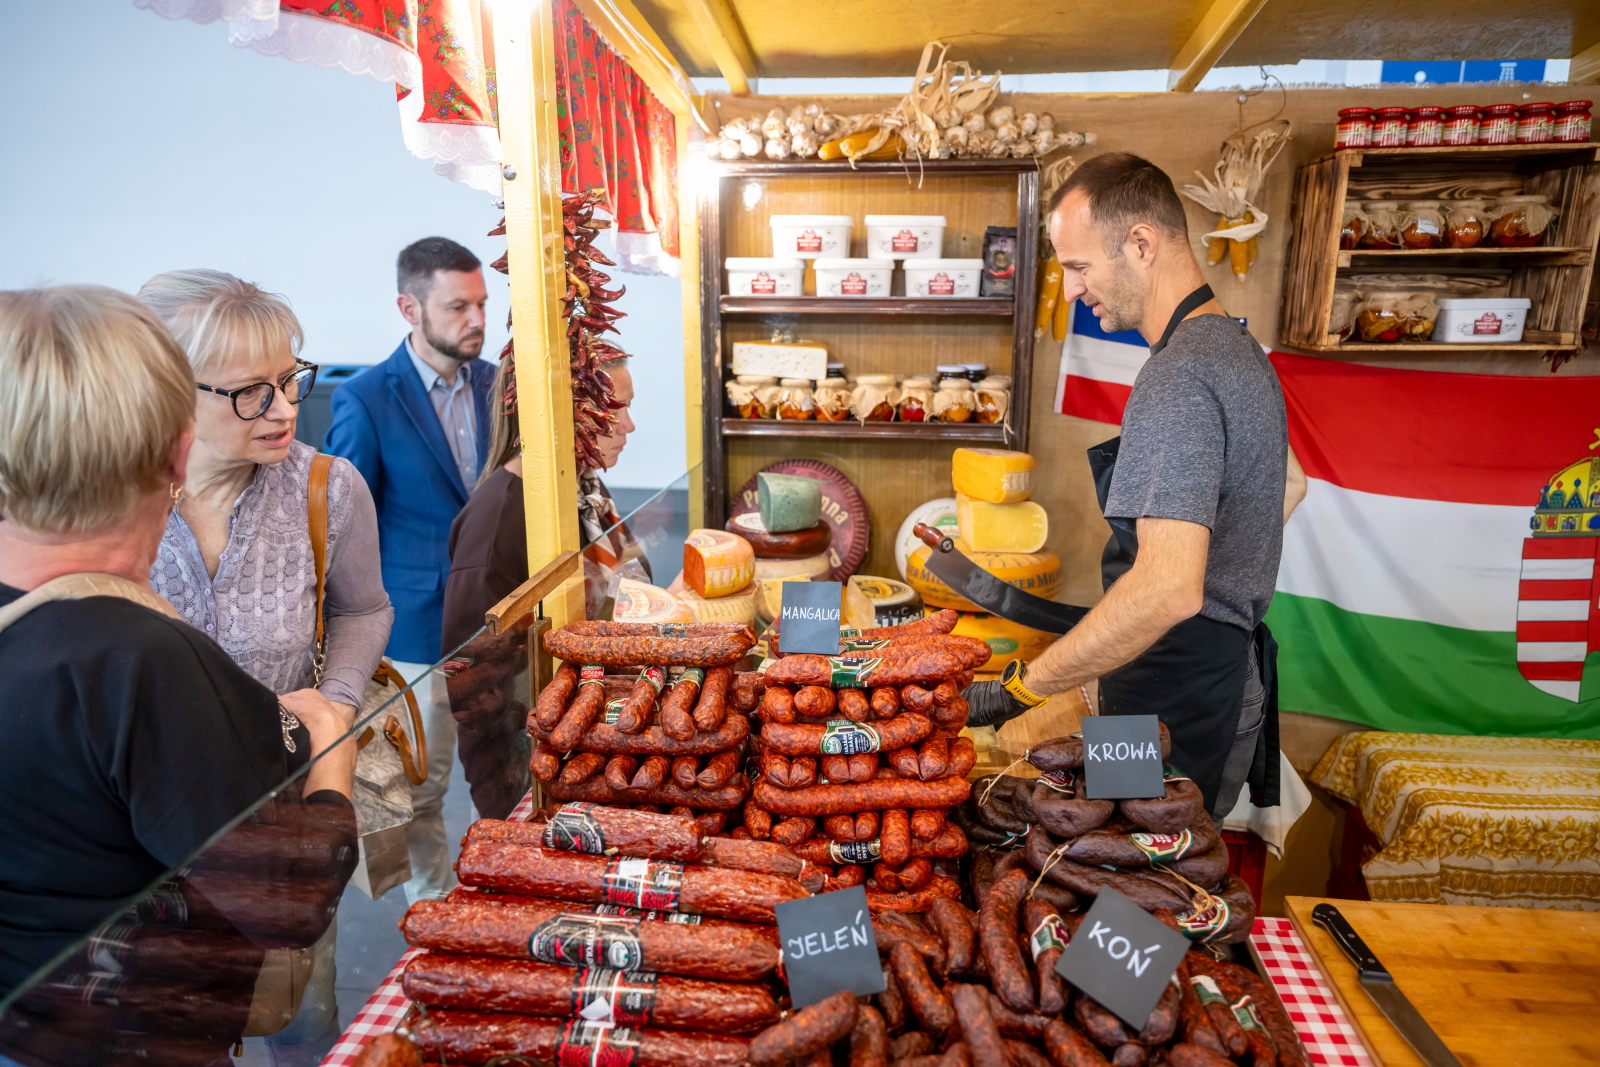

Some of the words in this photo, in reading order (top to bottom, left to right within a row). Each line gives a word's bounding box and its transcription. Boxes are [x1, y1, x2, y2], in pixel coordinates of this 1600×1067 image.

[782, 606, 841, 621] MANGALICA
[1087, 741, 1158, 763] KROWA
[787, 911, 869, 960] JELEŃ
[1087, 920, 1161, 978] KOŃ
